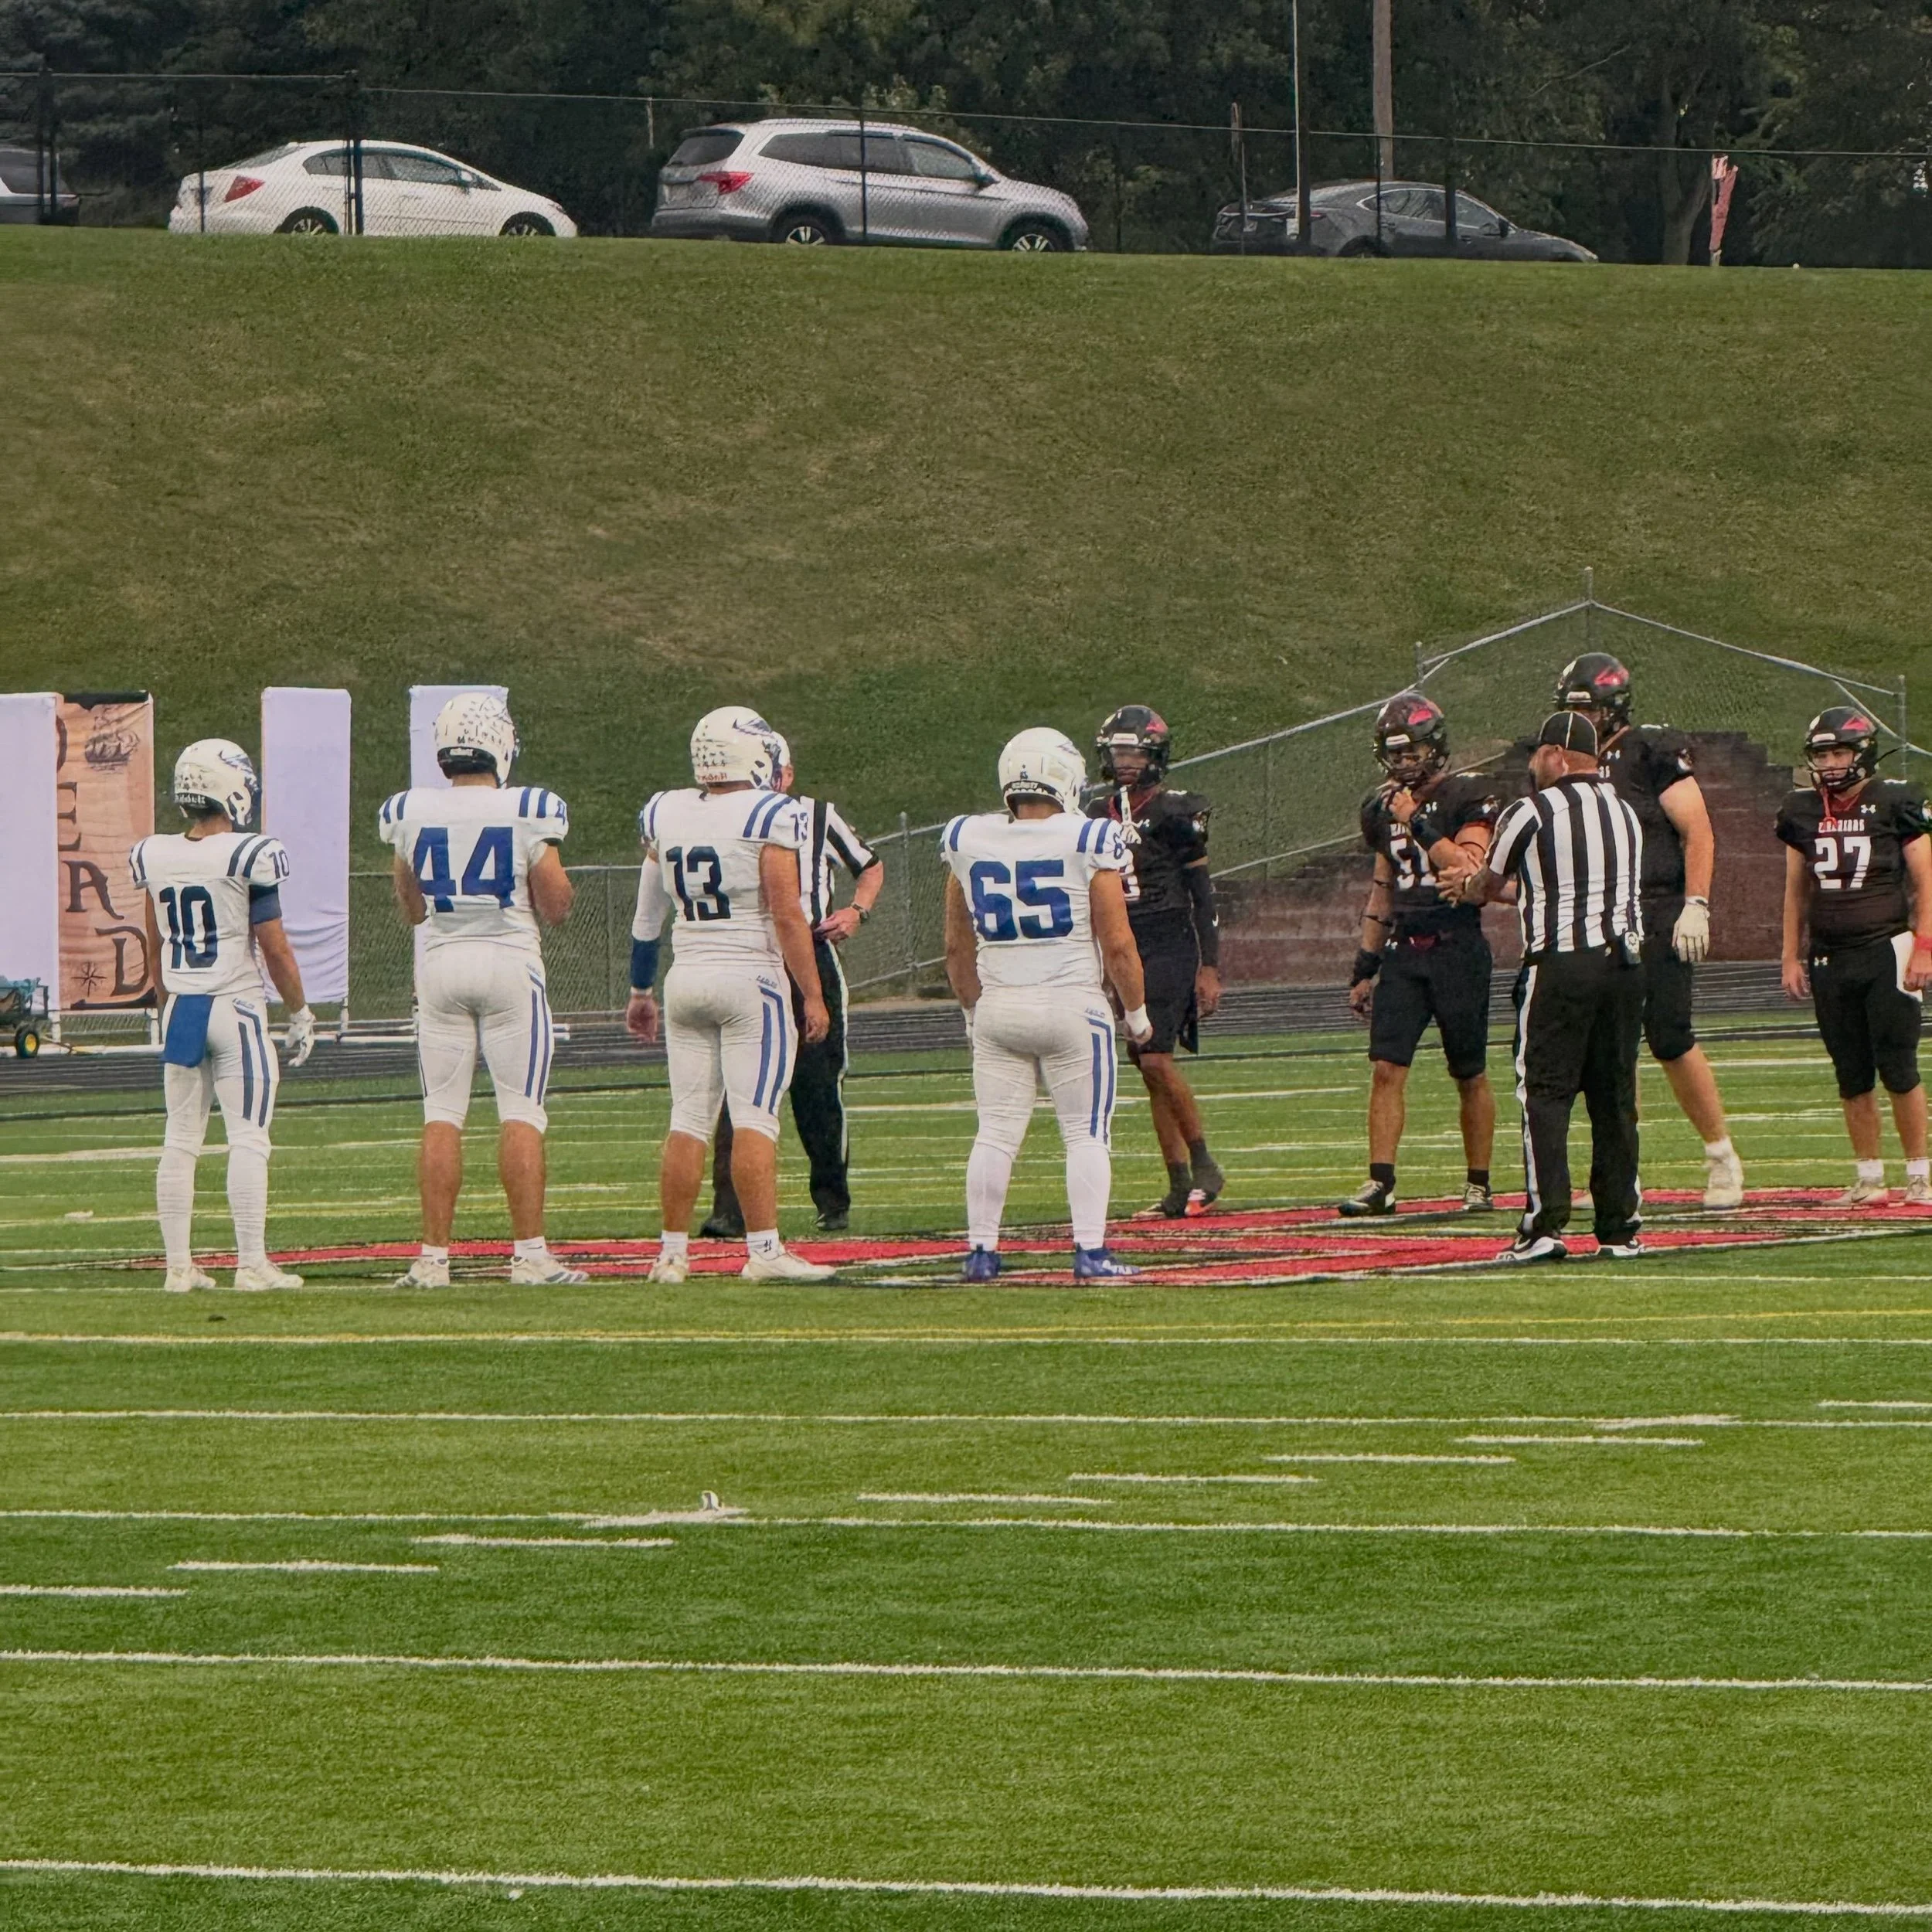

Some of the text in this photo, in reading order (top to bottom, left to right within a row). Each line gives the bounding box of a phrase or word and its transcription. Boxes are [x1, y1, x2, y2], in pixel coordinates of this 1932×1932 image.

[56, 715, 149, 997] EAD
[267, 849, 290, 879] 10
[790, 812, 809, 842] 13
[1814, 836, 1872, 889] 27
[413, 826, 515, 913] 44
[665, 845, 731, 922] 13
[969, 859, 1074, 941] 65
[159, 886, 218, 969] 10
